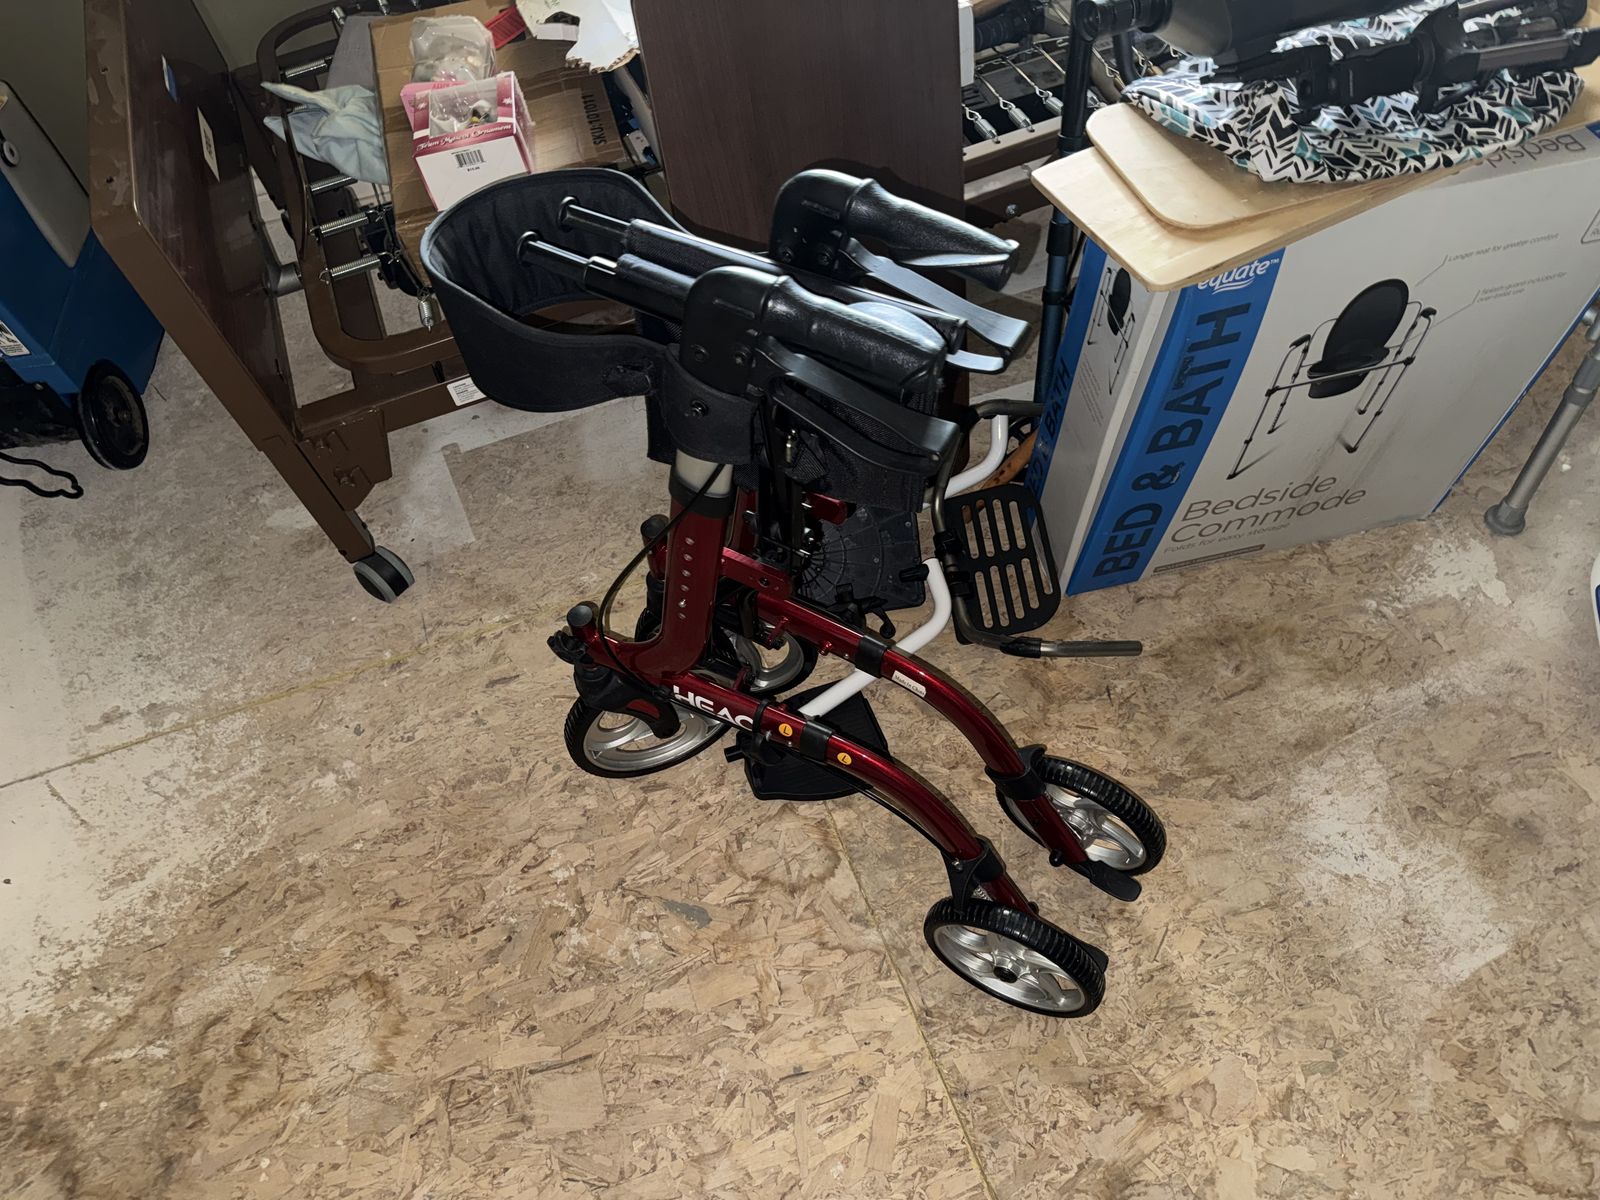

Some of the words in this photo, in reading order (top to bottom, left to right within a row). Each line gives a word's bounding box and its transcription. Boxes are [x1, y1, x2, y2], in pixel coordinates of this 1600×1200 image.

[1486, 134, 1586, 168] Bedsid
[1146, 301, 1252, 455] BATH
[1131, 461, 1185, 491] &
[1181, 476, 1337, 522] Bedside
[1093, 501, 1164, 577] BED
[1171, 489, 1366, 543] Commode
